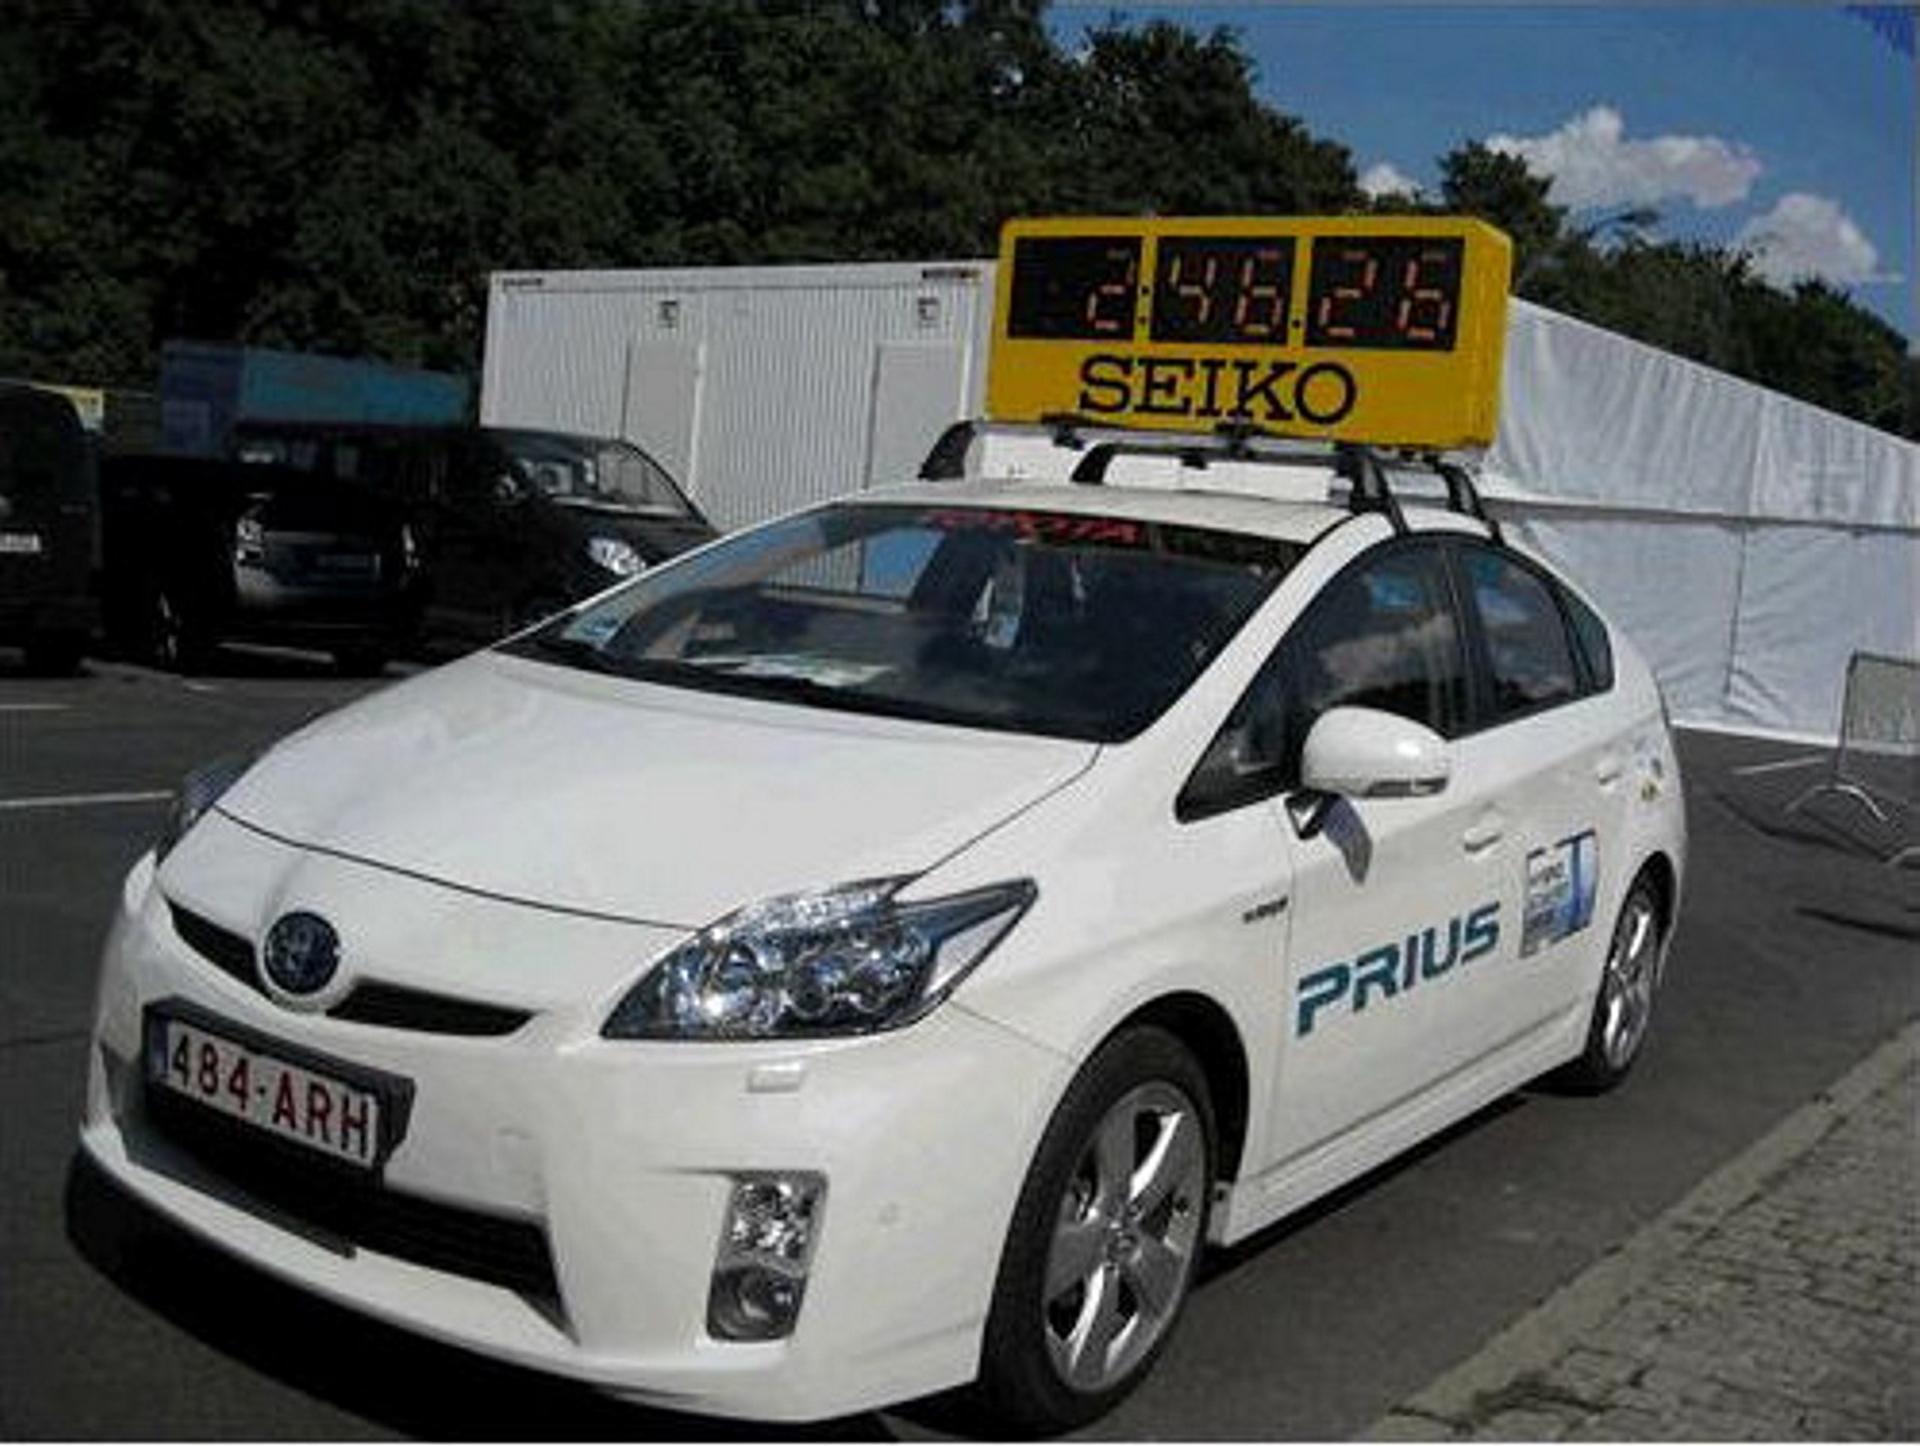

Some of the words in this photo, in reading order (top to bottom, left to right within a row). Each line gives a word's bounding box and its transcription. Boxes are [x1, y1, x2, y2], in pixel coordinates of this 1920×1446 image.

[1078, 354, 1358, 425] SEIKO
[1296, 901, 1501, 1038] PRIUS
[172, 1033, 369, 1159] 484-ARH
